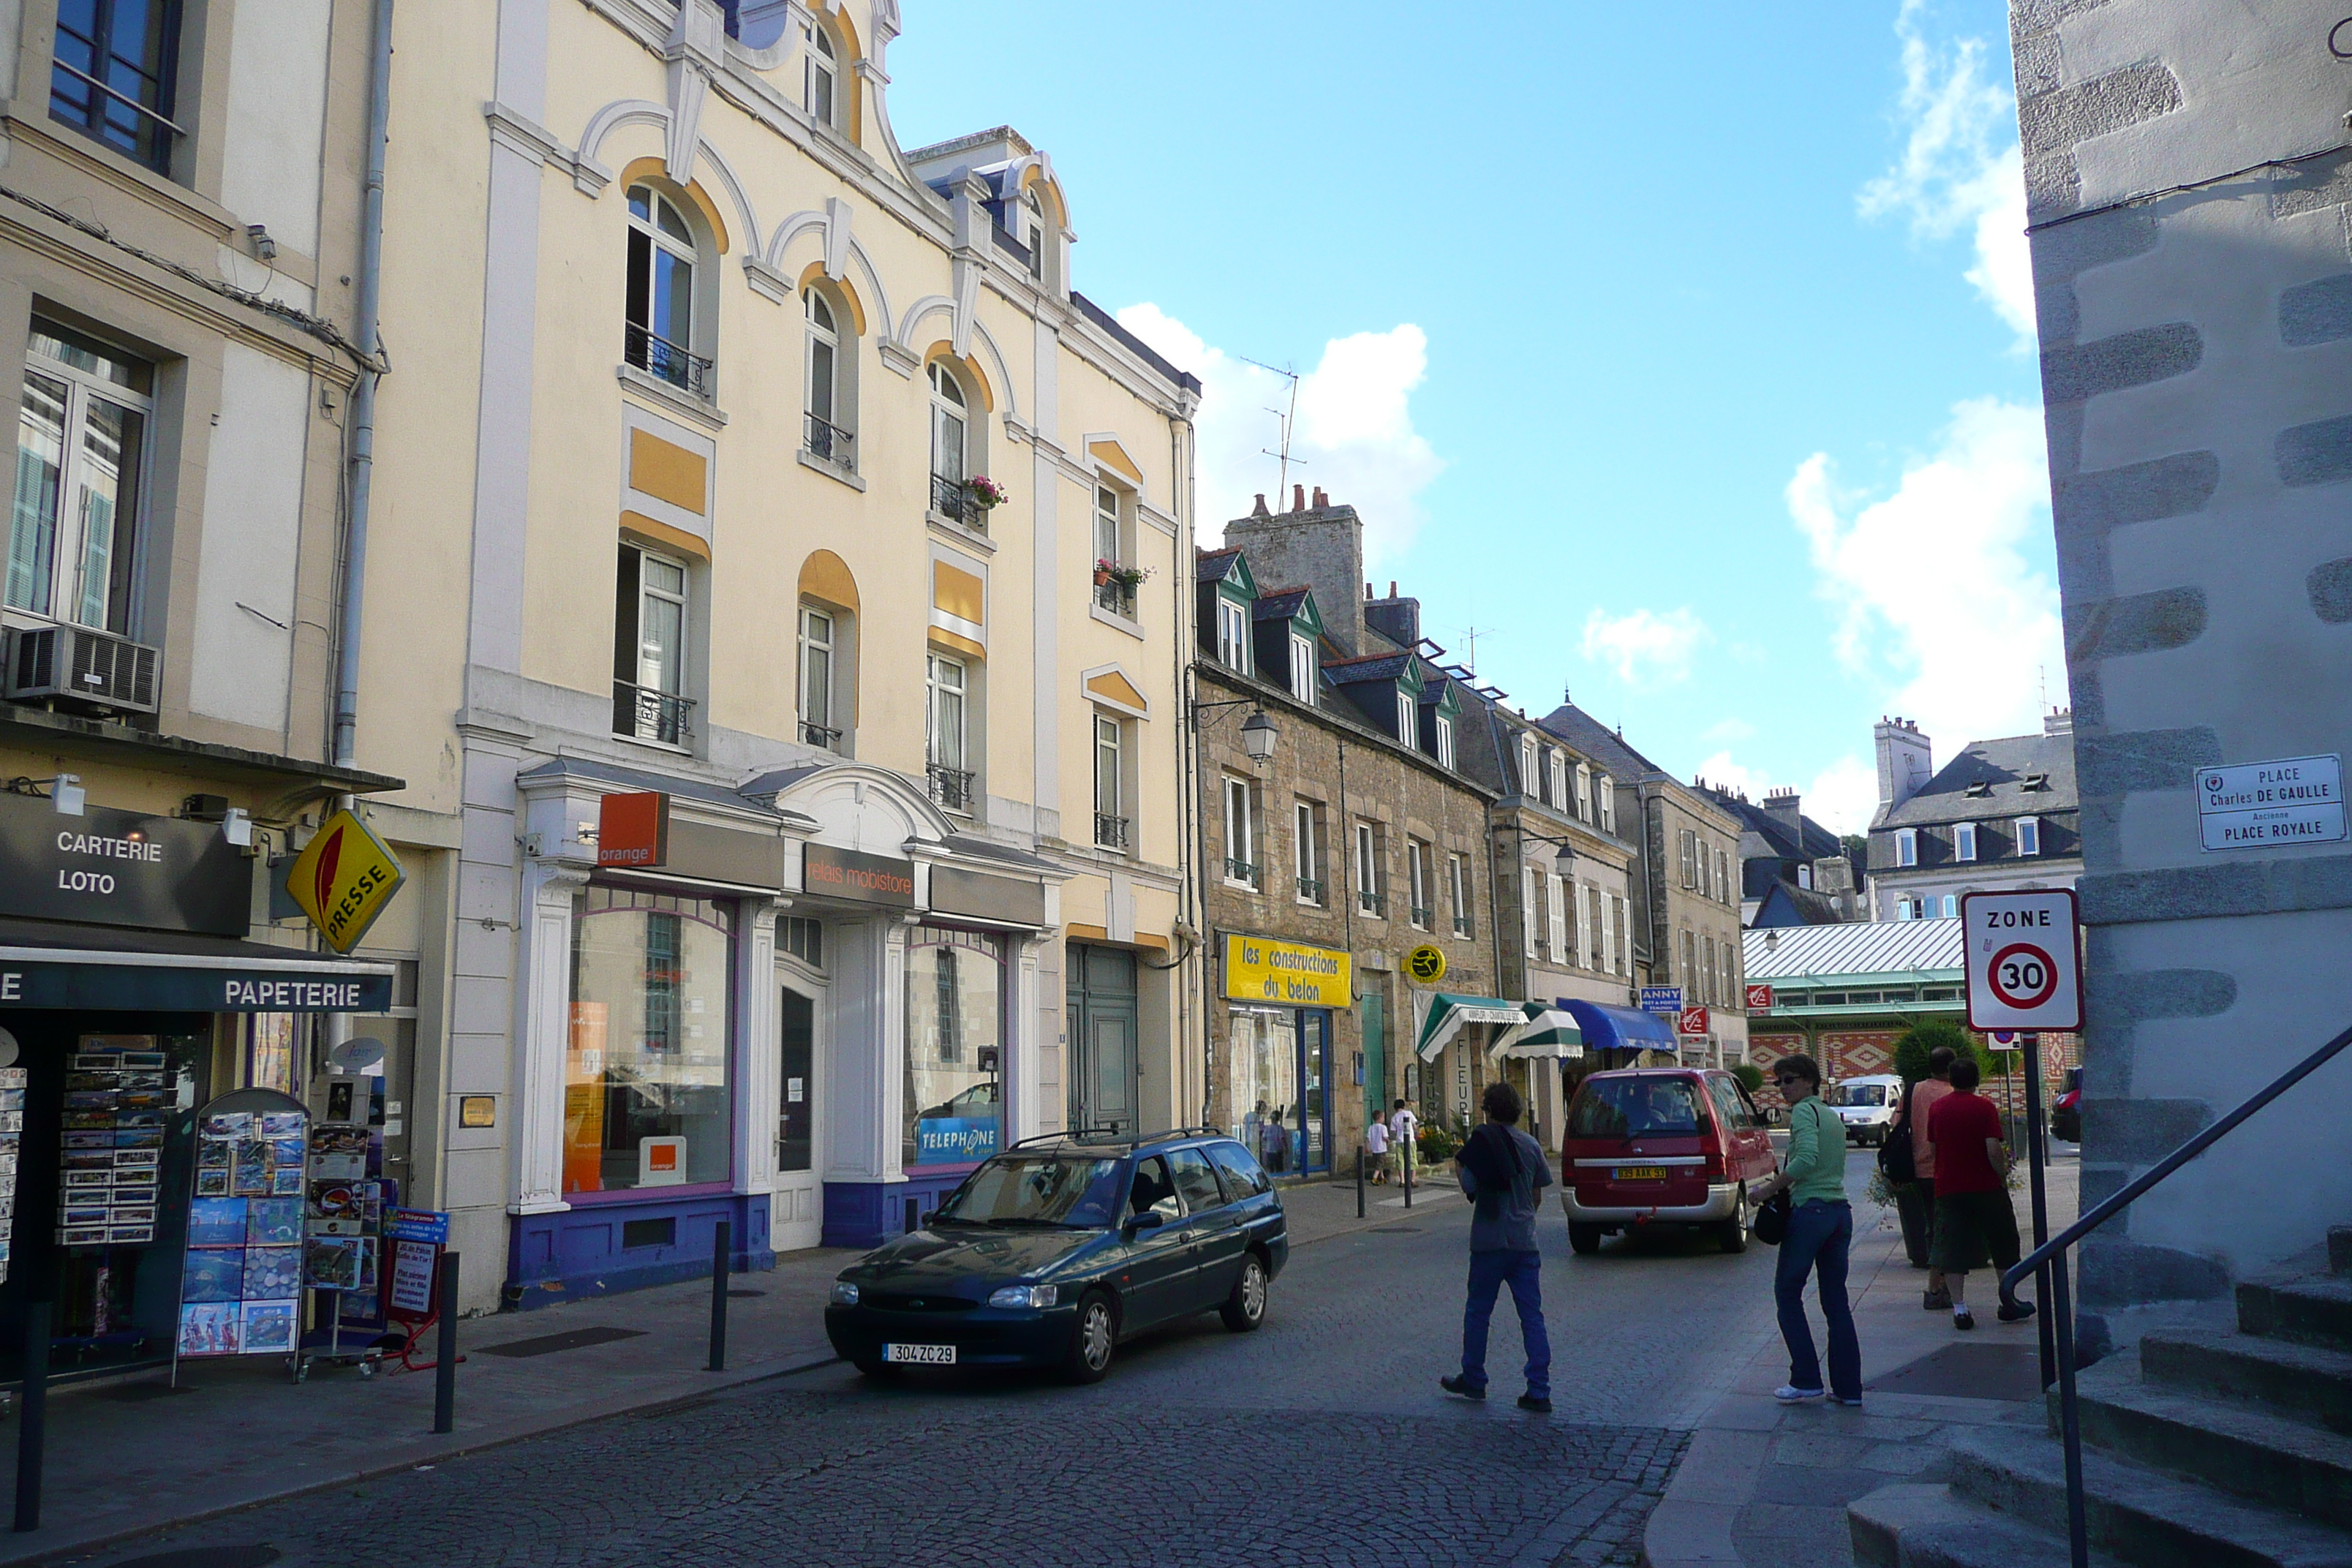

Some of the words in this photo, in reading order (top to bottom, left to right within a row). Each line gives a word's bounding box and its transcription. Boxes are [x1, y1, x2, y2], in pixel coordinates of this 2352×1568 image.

[2259, 768, 2300, 783] PLACE
[2211, 792, 2252, 807] Charles
[2258, 789, 2273, 802] DE
[2279, 783, 2329, 800] GAULLE
[2253, 811, 2289, 821] Ancienne
[2225, 826, 2264, 841] PLACE
[2272, 821, 2322, 837] ROYALE
[57, 832, 162, 862] CARTERIE
[600, 847, 648, 864] orange
[59, 869, 116, 894] LOTO
[807, 861, 843, 884] relais
[846, 868, 912, 894] mobistore
[328, 864, 387, 941] PRESSE
[1987, 910, 2051, 928] ZONE
[1242, 941, 1259, 965] les
[1268, 950, 1338, 975] constructions
[2002, 962, 2044, 990] 30
[226, 981, 361, 1007] PAPETERIE
[1264, 974, 1279, 996] du
[1287, 976, 1319, 1002] belon
[1643, 990, 1679, 999] ANNY
[923, 1129, 995, 1150] TELEPHONE
[1654, 1167, 1665, 1177] 93
[896, 1345, 918, 1360] 304
[920, 1346, 935, 1361] ZC
[937, 1347, 952, 1362] 29
